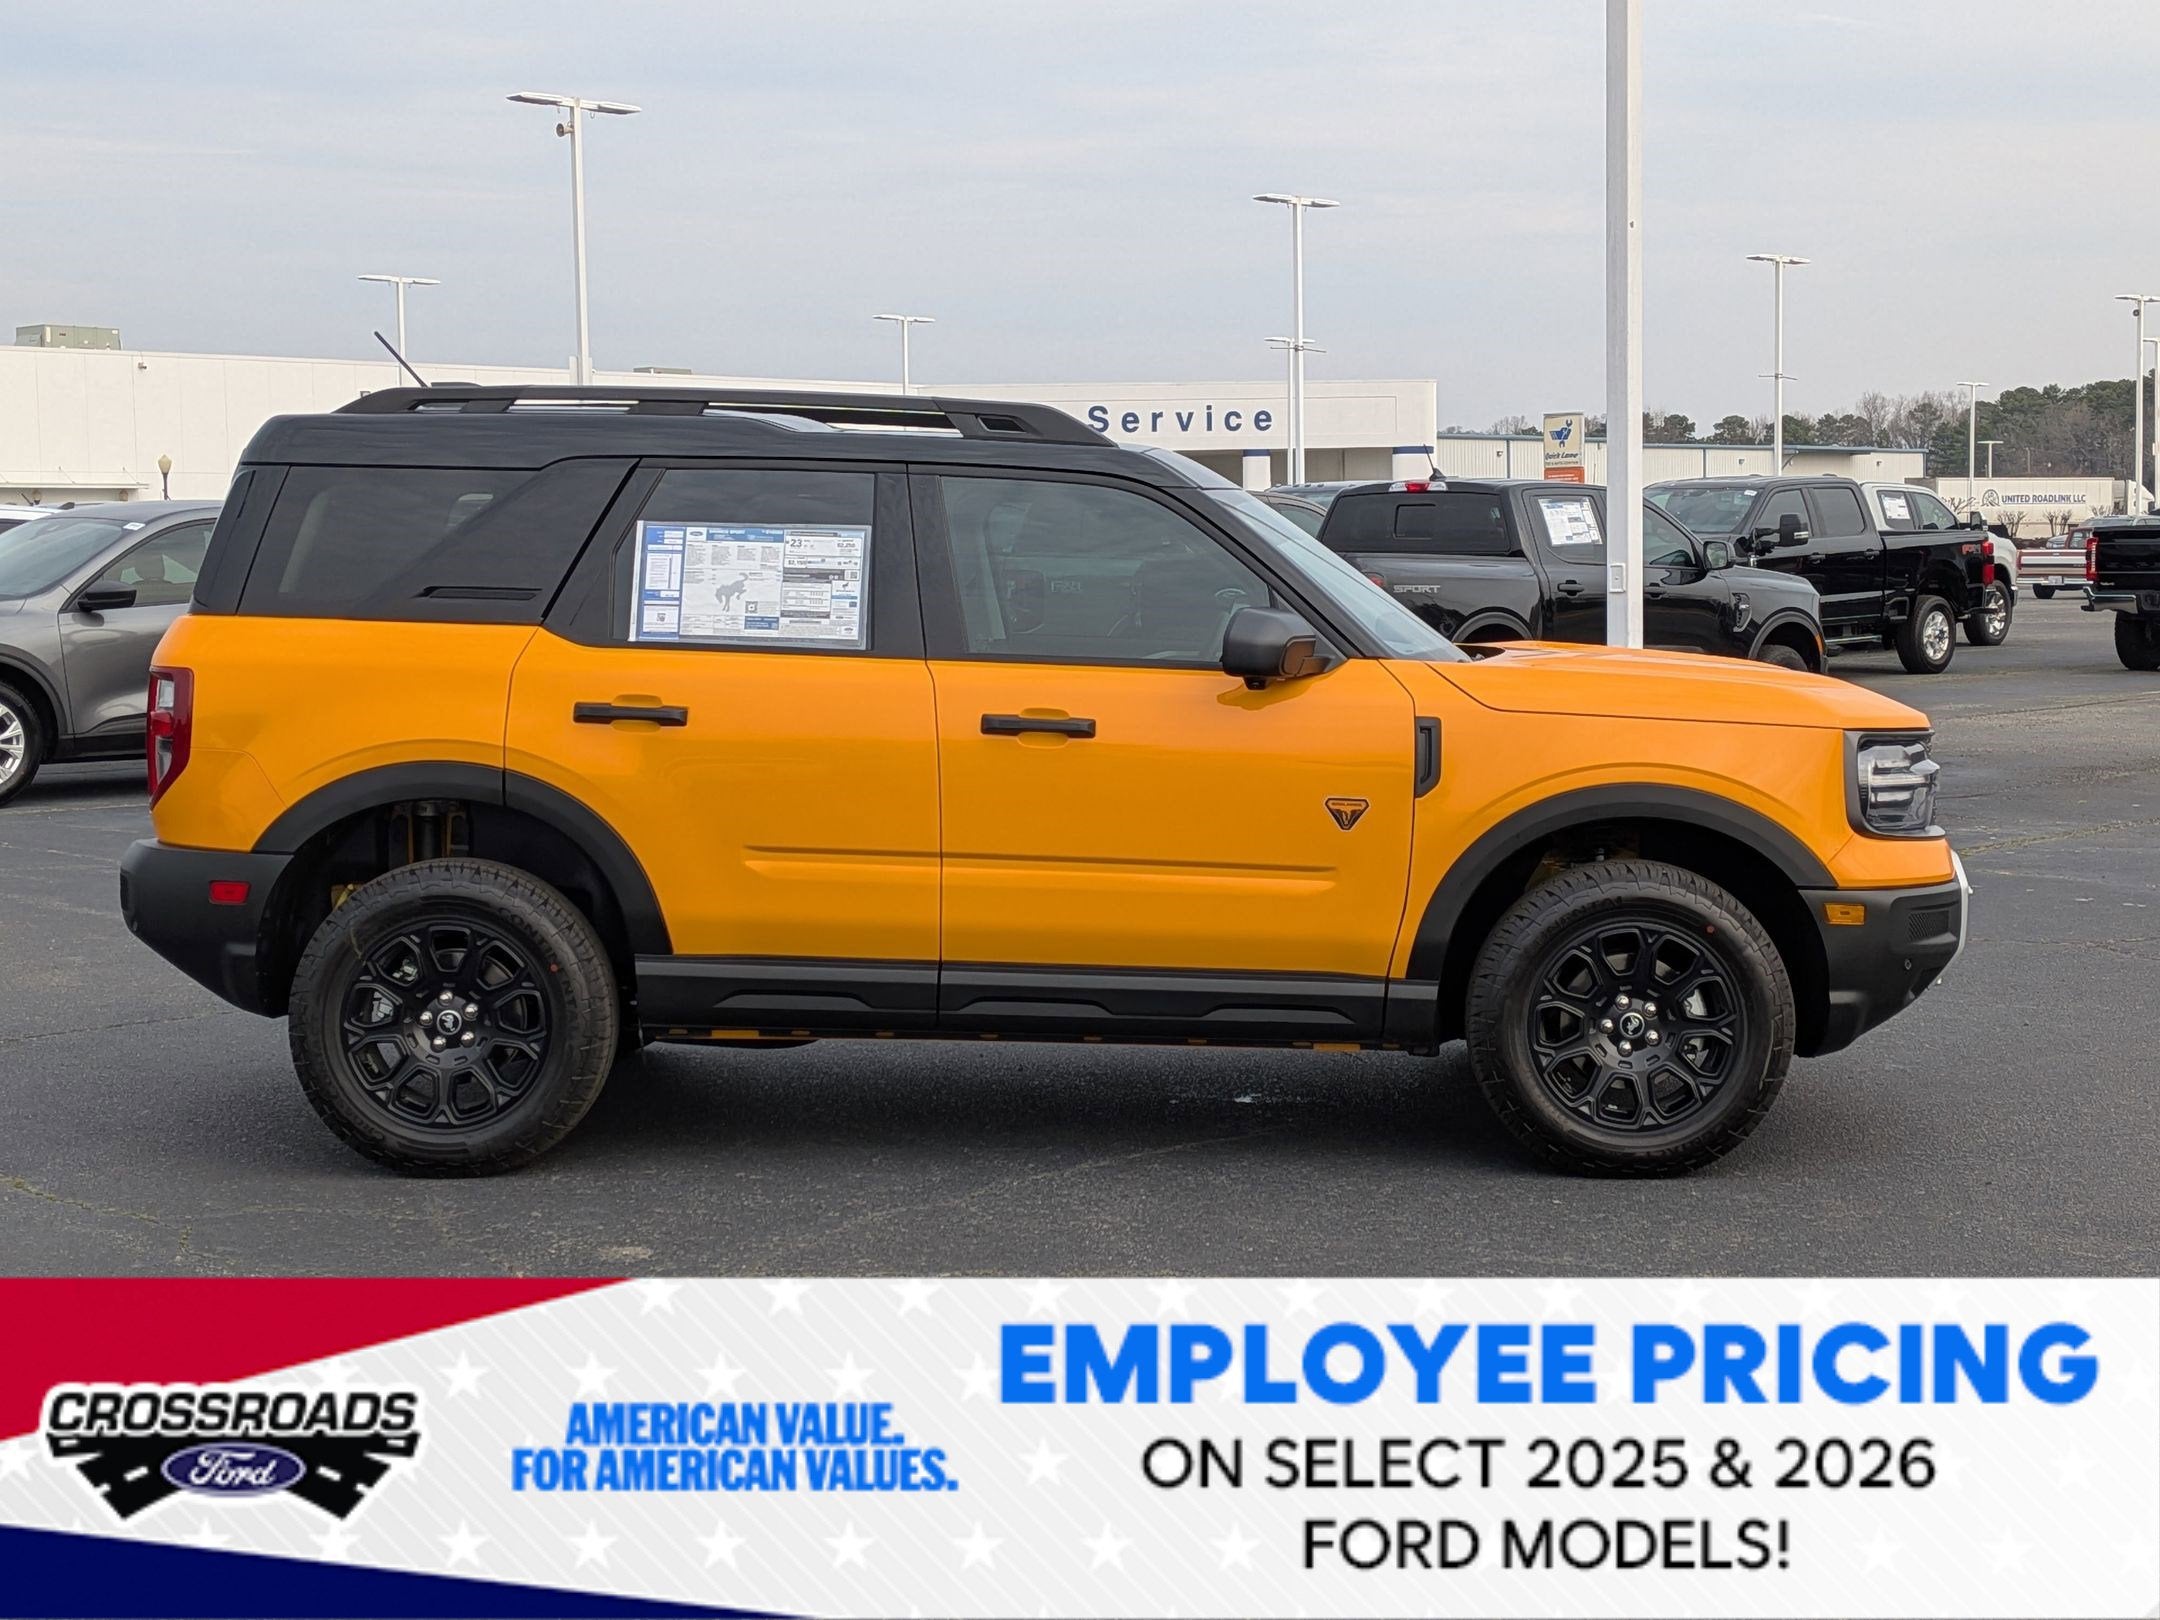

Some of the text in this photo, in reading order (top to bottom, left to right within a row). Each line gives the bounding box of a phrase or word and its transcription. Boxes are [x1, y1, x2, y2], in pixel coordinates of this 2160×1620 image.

[1088, 405, 1272, 432] Service
[2001, 494, 2086, 503] UNITED ROADLINK LLC
[790, 539, 802, 548] 23
[1393, 585, 1441, 593] SPORT
